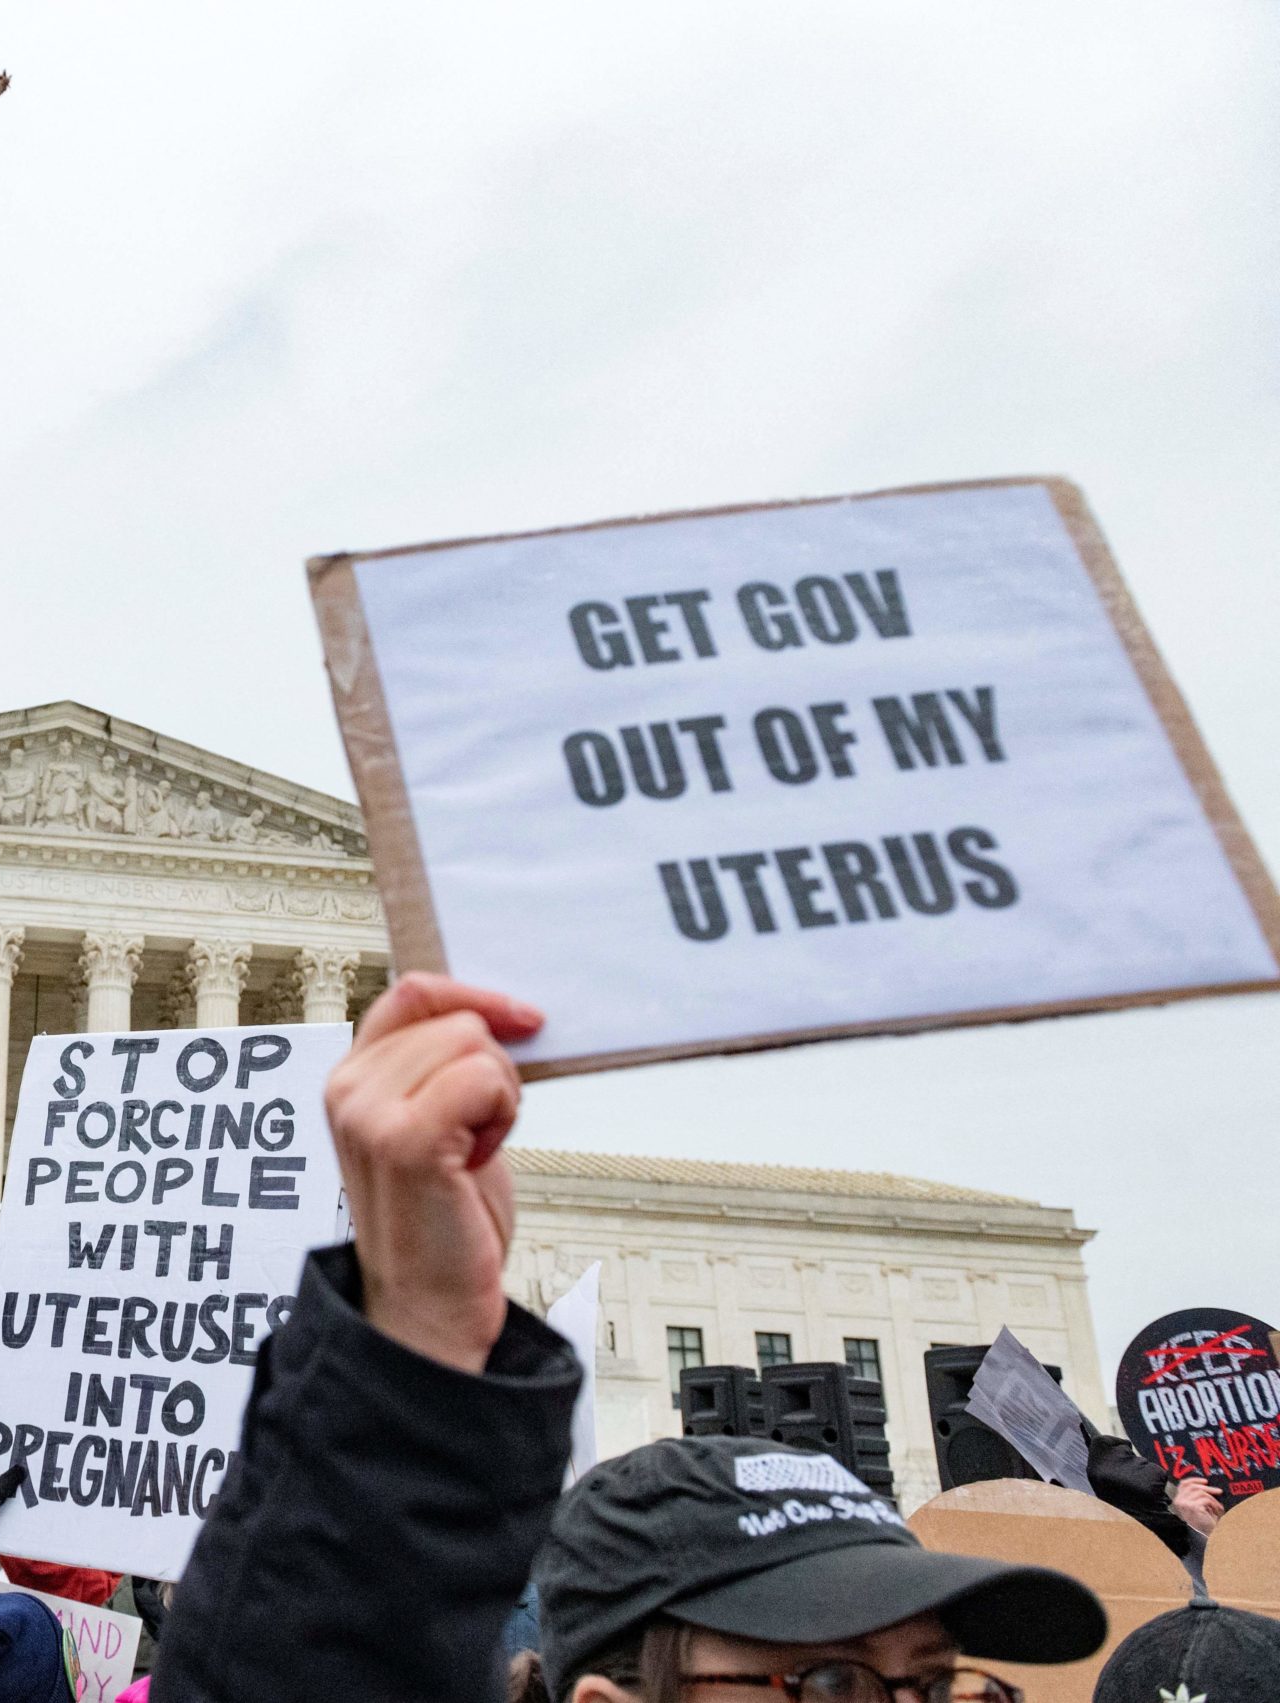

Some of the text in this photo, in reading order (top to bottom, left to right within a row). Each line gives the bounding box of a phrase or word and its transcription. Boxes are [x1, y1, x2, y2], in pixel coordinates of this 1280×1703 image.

[567, 568, 913, 672] GET GOV
[562, 685, 1009, 809] OUT OF MY
[657, 825, 1020, 943] UTERUS
[52, 1034, 293, 1100] STOP
[43, 1098, 296, 1155] FORCING
[24, 1155, 307, 1210] PEOPLE
[68, 1219, 235, 1281] WITH
[64, 1372, 206, 1437] INTO
